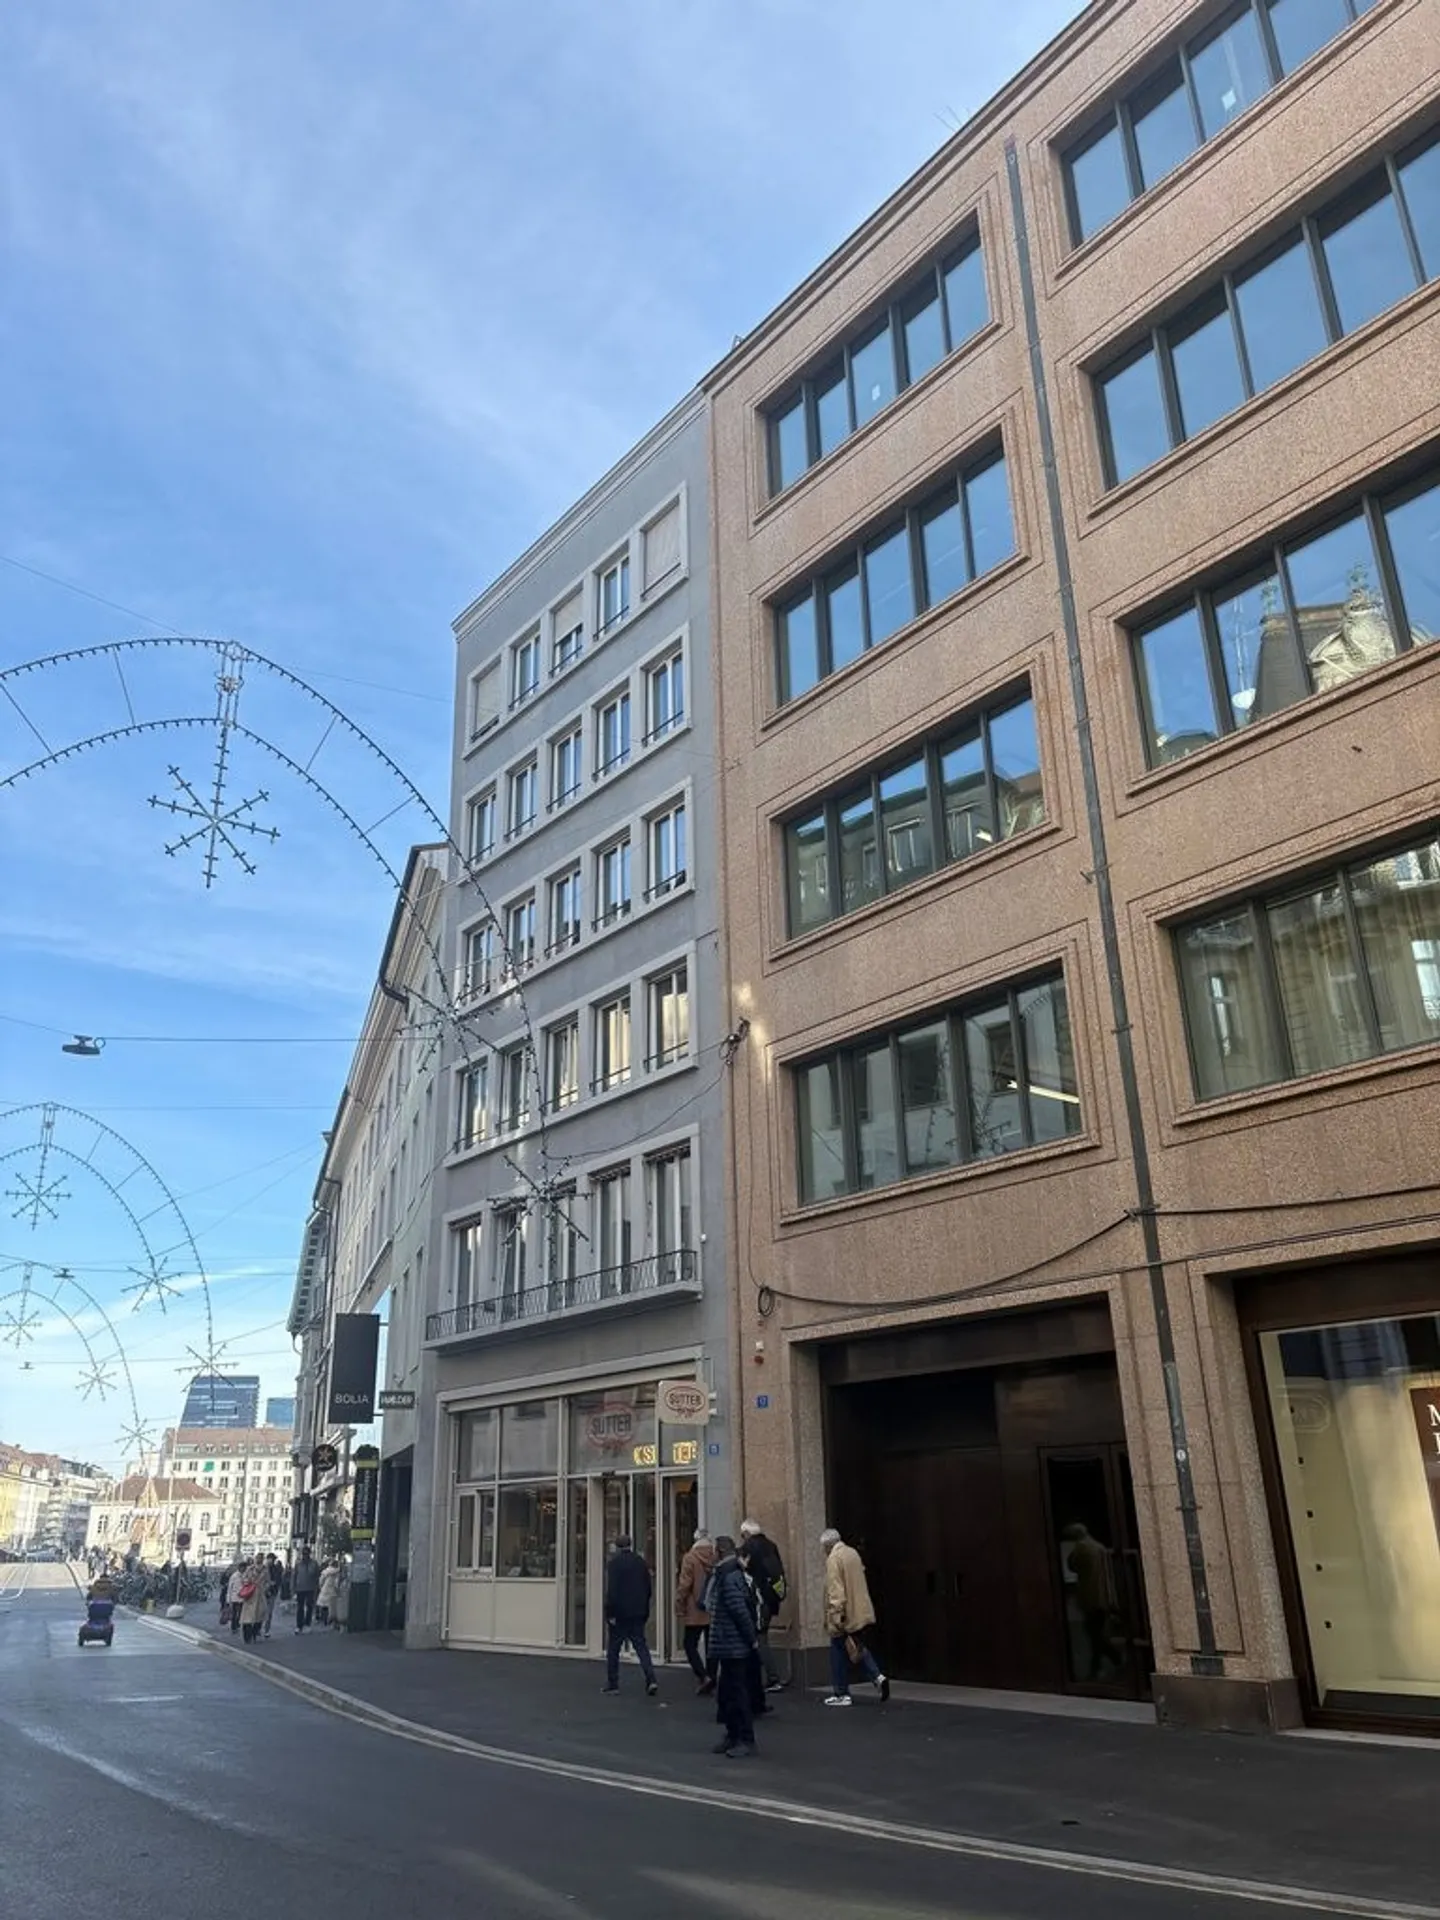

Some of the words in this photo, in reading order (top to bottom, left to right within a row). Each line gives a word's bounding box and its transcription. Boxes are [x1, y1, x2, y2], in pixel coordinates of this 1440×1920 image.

[335, 1392, 369, 1405] BOLIA
[670, 1393, 702, 1406] SUTTER
[591, 1413, 632, 1437] SUTTER
